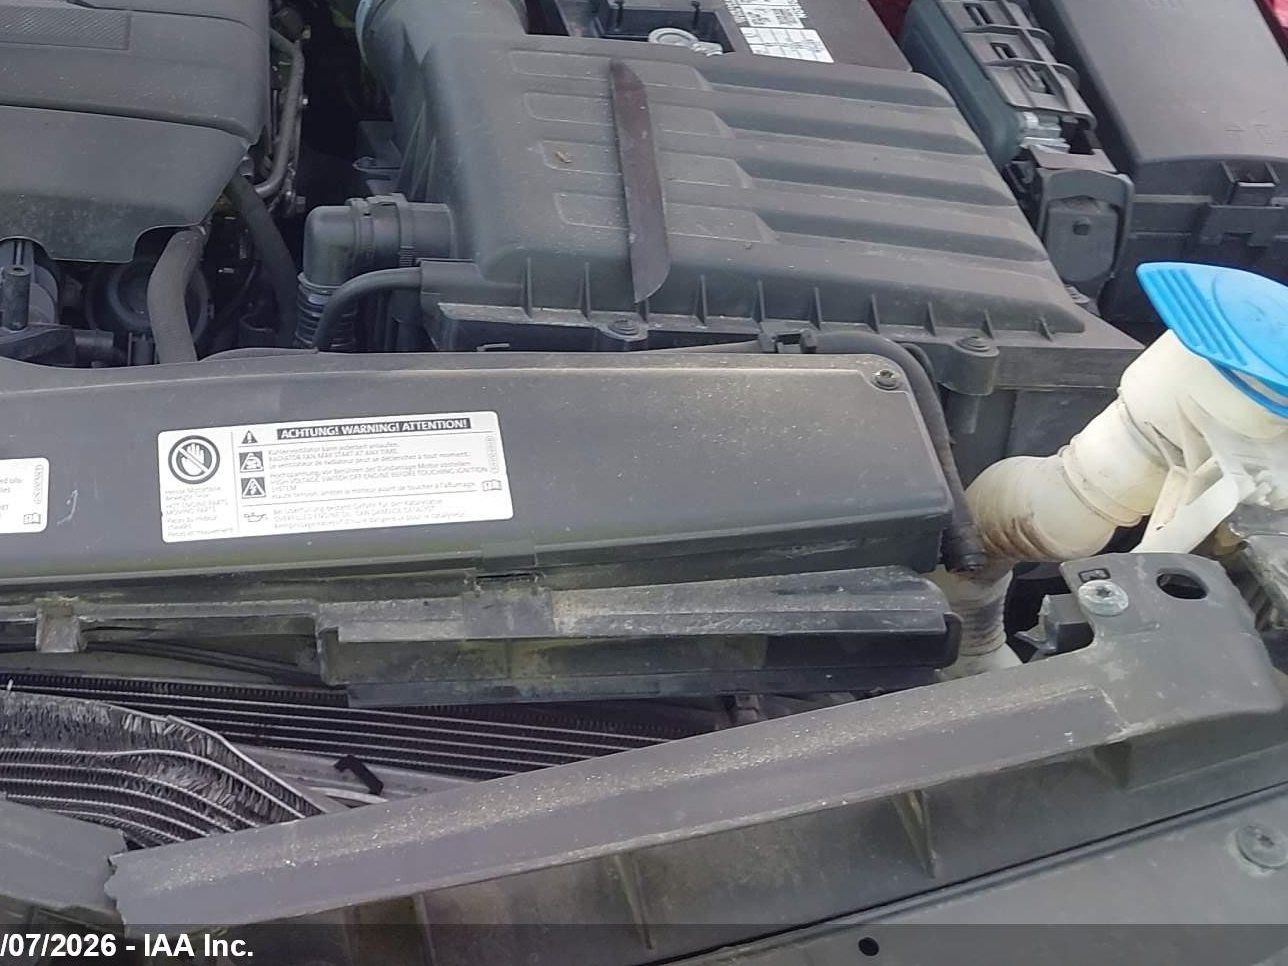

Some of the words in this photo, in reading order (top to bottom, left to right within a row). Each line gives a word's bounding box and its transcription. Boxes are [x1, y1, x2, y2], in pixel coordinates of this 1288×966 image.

[281, 426, 338, 438] ACHTUNG!
[341, 422, 399, 434] WARNING!
[401, 418, 466, 431] ATTENTION!
